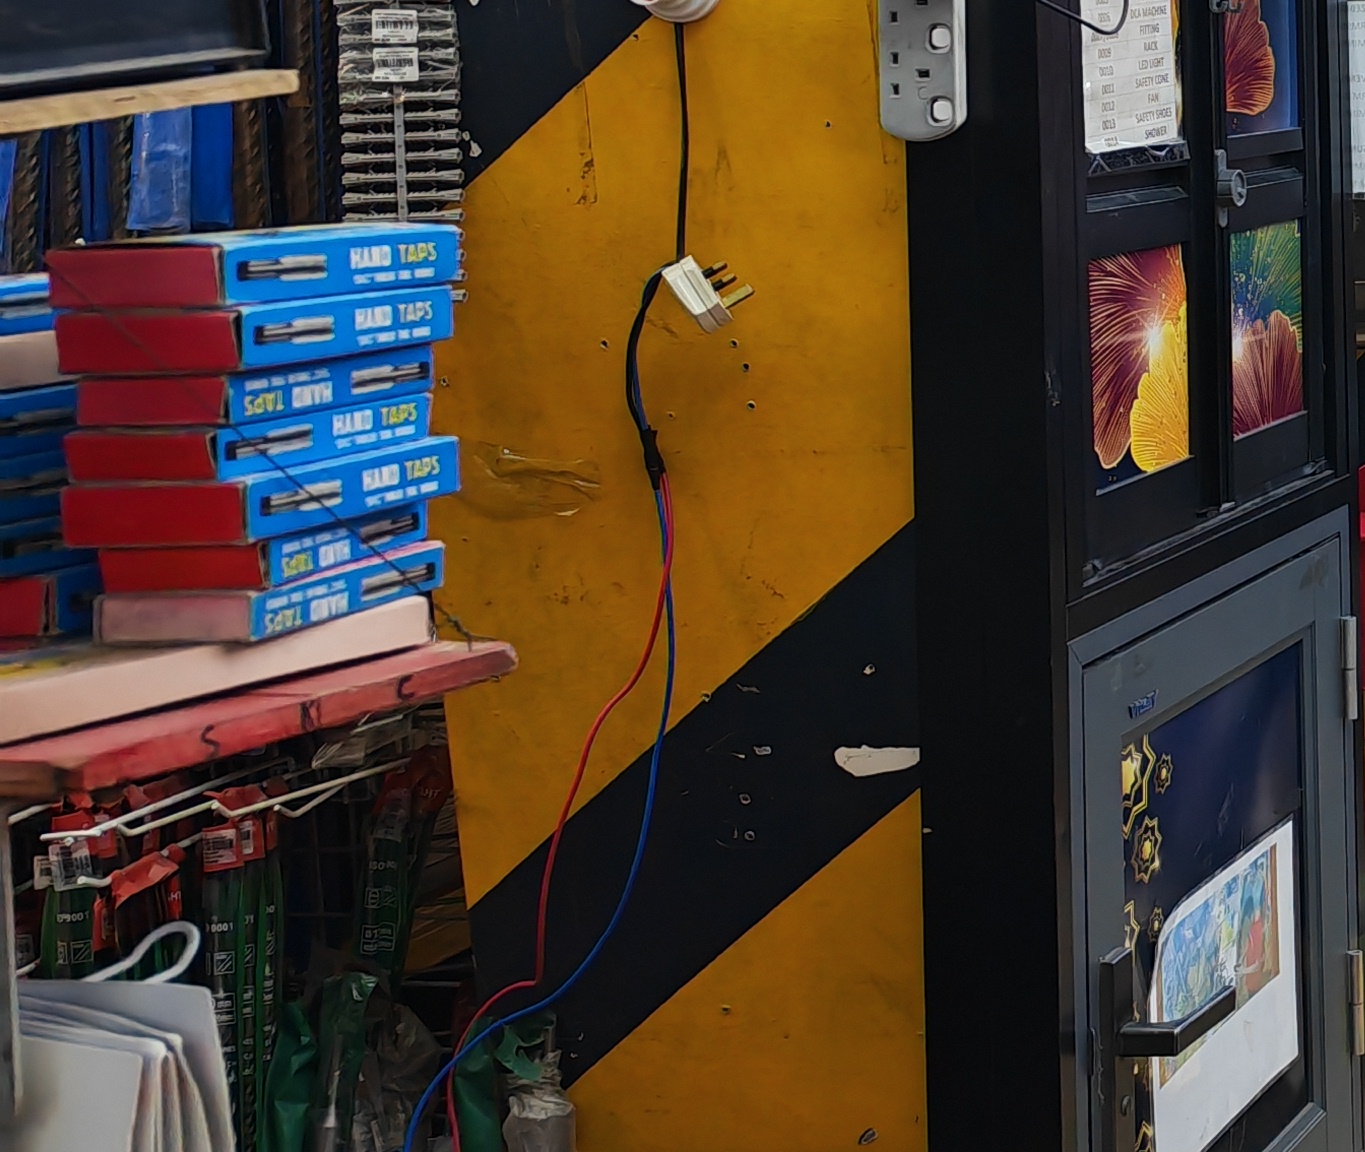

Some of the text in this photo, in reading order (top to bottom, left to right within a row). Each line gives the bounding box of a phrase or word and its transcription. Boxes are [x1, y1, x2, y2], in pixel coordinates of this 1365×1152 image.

[1139, 22, 1160, 35] FITTING
[1144, 126, 1168, 140] SHOWER
[398, 243, 437, 263] TAPS
[397, 301, 433, 323] TAPS
